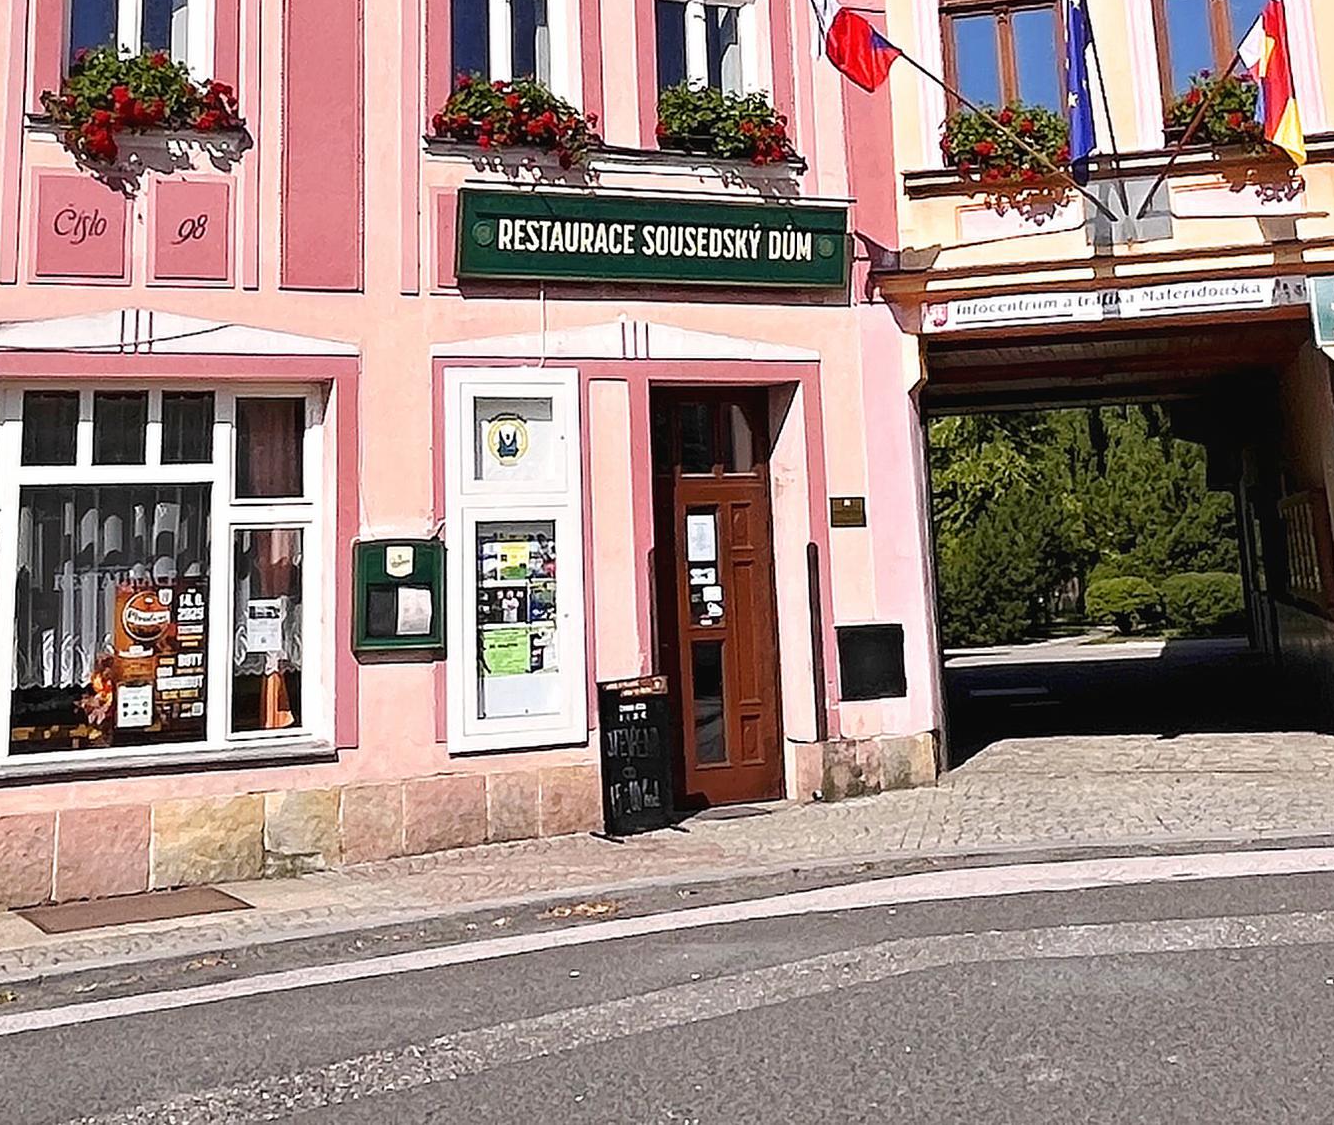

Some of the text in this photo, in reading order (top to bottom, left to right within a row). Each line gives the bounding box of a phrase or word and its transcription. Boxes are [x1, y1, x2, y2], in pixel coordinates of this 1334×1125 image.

[170, 214, 208, 245] 98
[497, 218, 813, 261] RESTAURACE SOUSEDSKÝ DŮM
